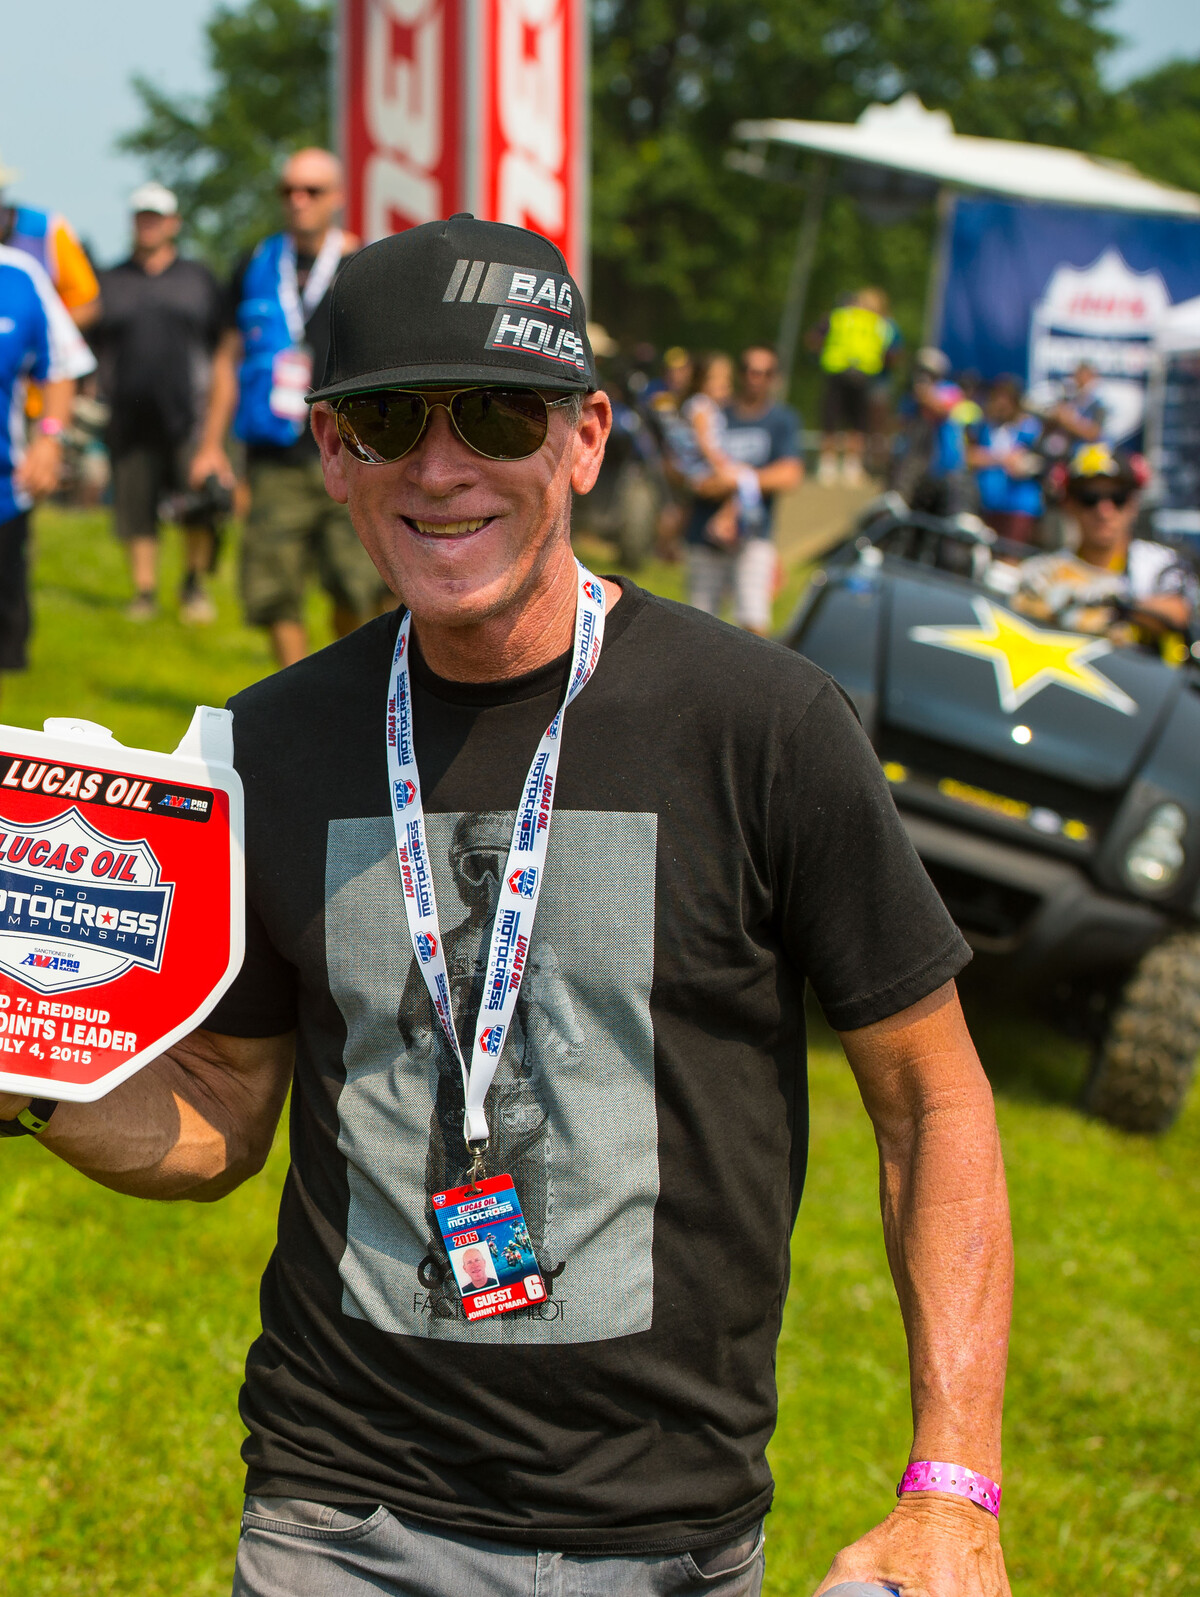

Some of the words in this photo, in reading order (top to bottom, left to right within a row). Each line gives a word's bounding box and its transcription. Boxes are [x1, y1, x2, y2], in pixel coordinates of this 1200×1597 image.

[507, 272, 573, 315] BAG
[388, 715, 397, 747] LUCAS
[400, 671, 411, 766] MOTOCROSS
[2, 760, 102, 801] LUCAS
[540, 774, 553, 812] LUCAS
[158, 794, 192, 810] AMA
[190, 799, 209, 809] PRO
[518, 752, 547, 852] MOTOCROSS
[401, 864, 415, 898] LUCAS
[410, 819, 431, 918] MOTOCROSS
[33, 885, 87, 900] PRO
[19, 952, 60, 970] AMA
[59, 958, 80, 969] PRO
[34, 947, 67, 957] SANCTIONED
[489, 909, 516, 1010] MOTOCROSS
[513, 934, 528, 971] LUCAS
[16, 998, 32, 1013] 7:
[37, 1000, 111, 1025] REDBUD
[61, 1022, 138, 1053] LEADER
[29, 1043, 46, 1060] 4,
[50, 1046, 92, 1065] 2015
[448, 1203, 513, 1228] MOTOCROSS
[460, 1201, 483, 1213] LUCAS
[483, 1197, 496, 1206] OIL
[453, 1231, 478, 1247] 2015
[473, 1288, 513, 1308] GUEST
[525, 1275, 544, 1300] 6
[467, 1307, 496, 1321] JOHNNY
[498, 1298, 528, 1312] O'MARA
